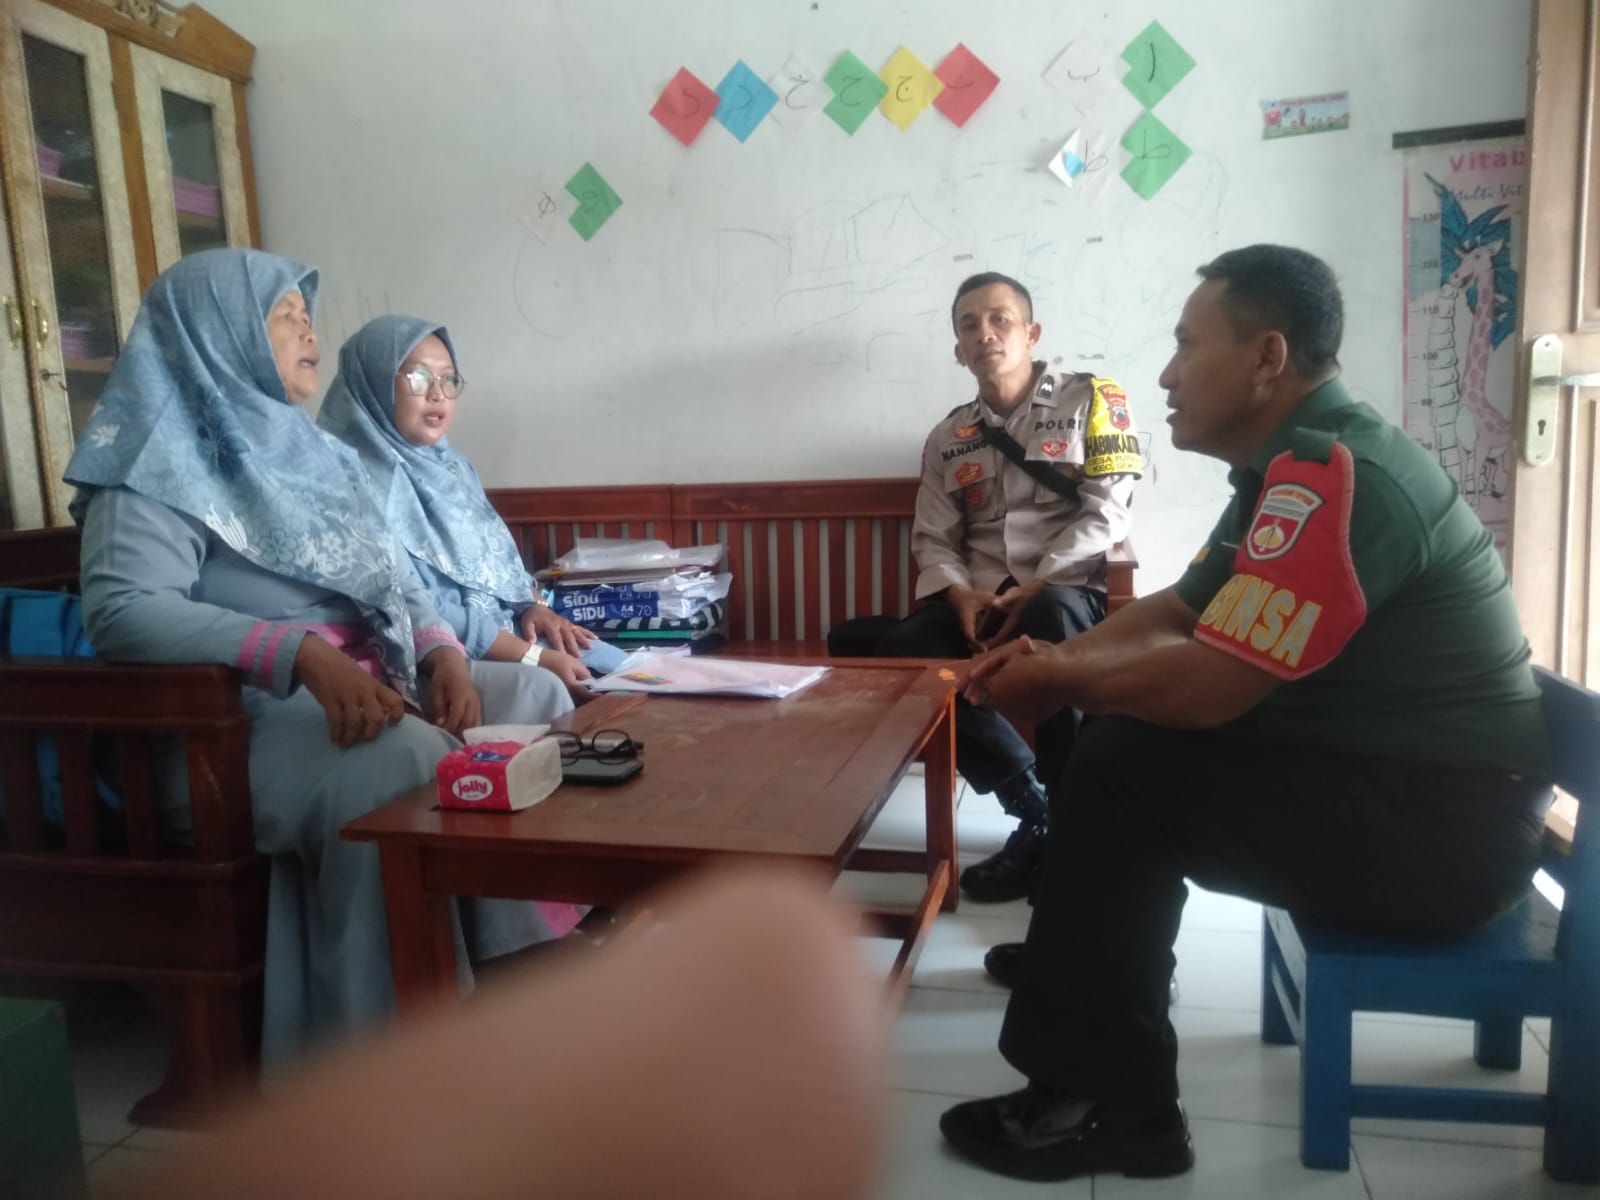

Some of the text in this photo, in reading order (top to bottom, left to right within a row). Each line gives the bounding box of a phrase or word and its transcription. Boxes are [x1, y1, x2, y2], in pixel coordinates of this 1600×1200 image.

[1067, 65, 1100, 83] ب
[785, 73, 810, 109] خ
[840, 75, 862, 107] ح
[896, 75, 914, 103] ج
[1136, 129, 1172, 160] ط
[1034, 418, 1082, 432] POLRI
[458, 780, 488, 797] jolly
